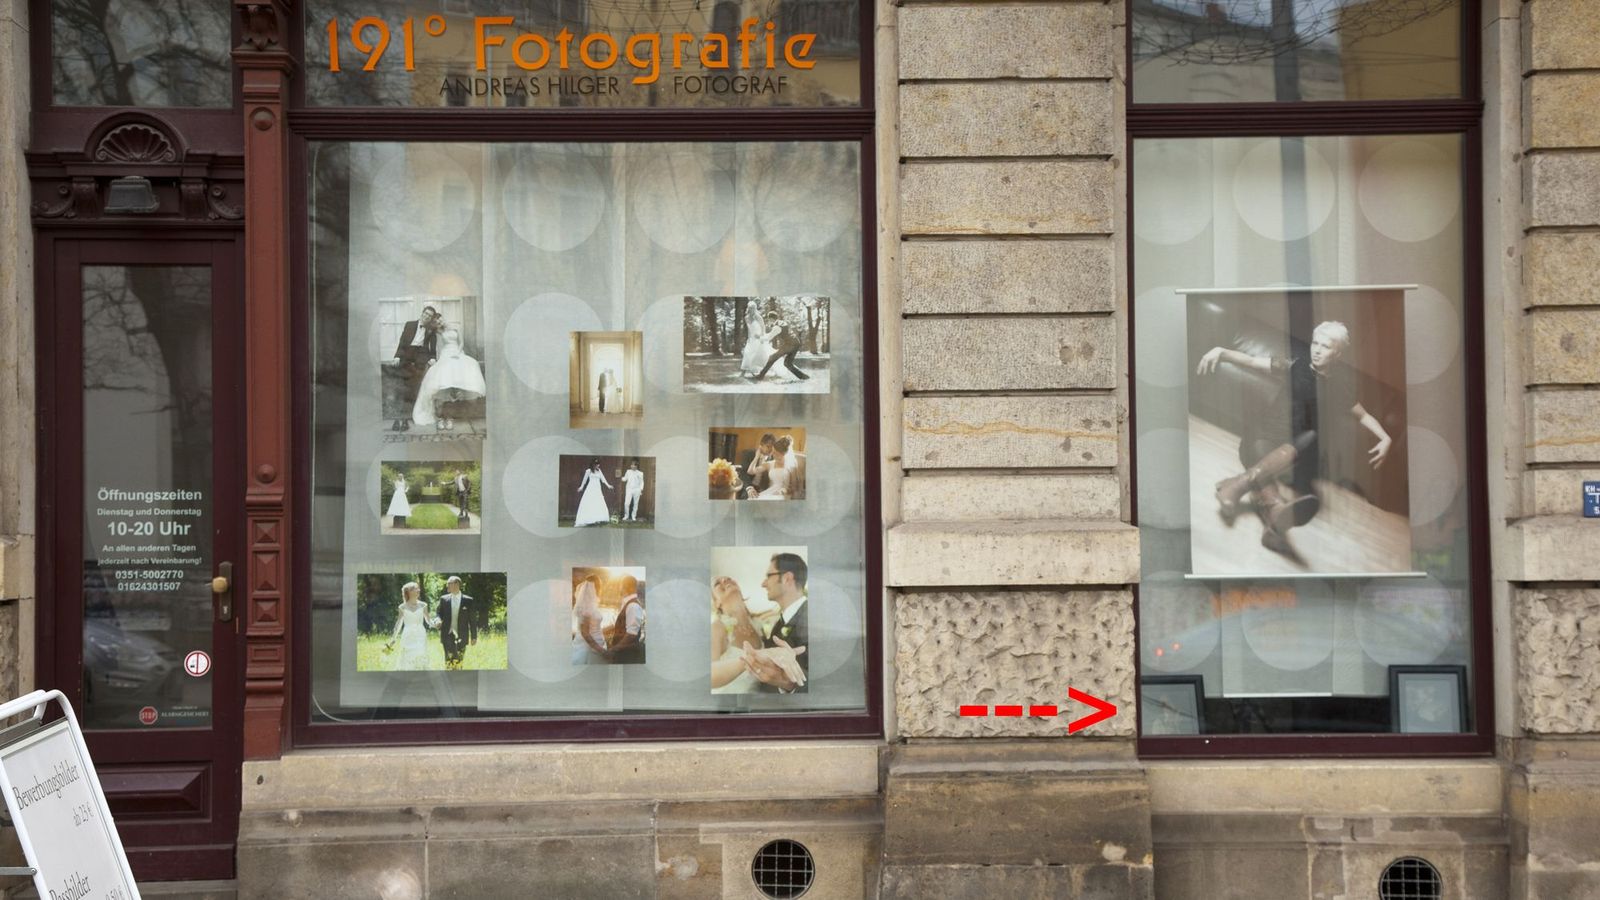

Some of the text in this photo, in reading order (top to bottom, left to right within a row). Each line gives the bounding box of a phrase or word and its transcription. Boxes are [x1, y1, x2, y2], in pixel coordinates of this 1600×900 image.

[474, 15, 817, 85] Fotografie
[439, 75, 787, 96] ANDREAS HILGER FOTOGRAF
[97, 487, 202, 503] Öffnungszeiten
[97, 508, 134, 517] Dienstag
[154, 508, 202, 517] Donnerstag
[107, 521, 192, 536] 10-20 Uhr
[116, 544, 135, 552] allen
[137, 544, 170, 552] anderen
[172, 544, 196, 553] Tagen
[97, 557, 129, 566] jederzeit
[150, 557, 202, 566] Vereinbarung!
[115, 570, 184, 579] 0351-5002770
[12, 760, 80, 811] Bewerbungsbilder
[49, 871, 91, 900] Pssbilder
